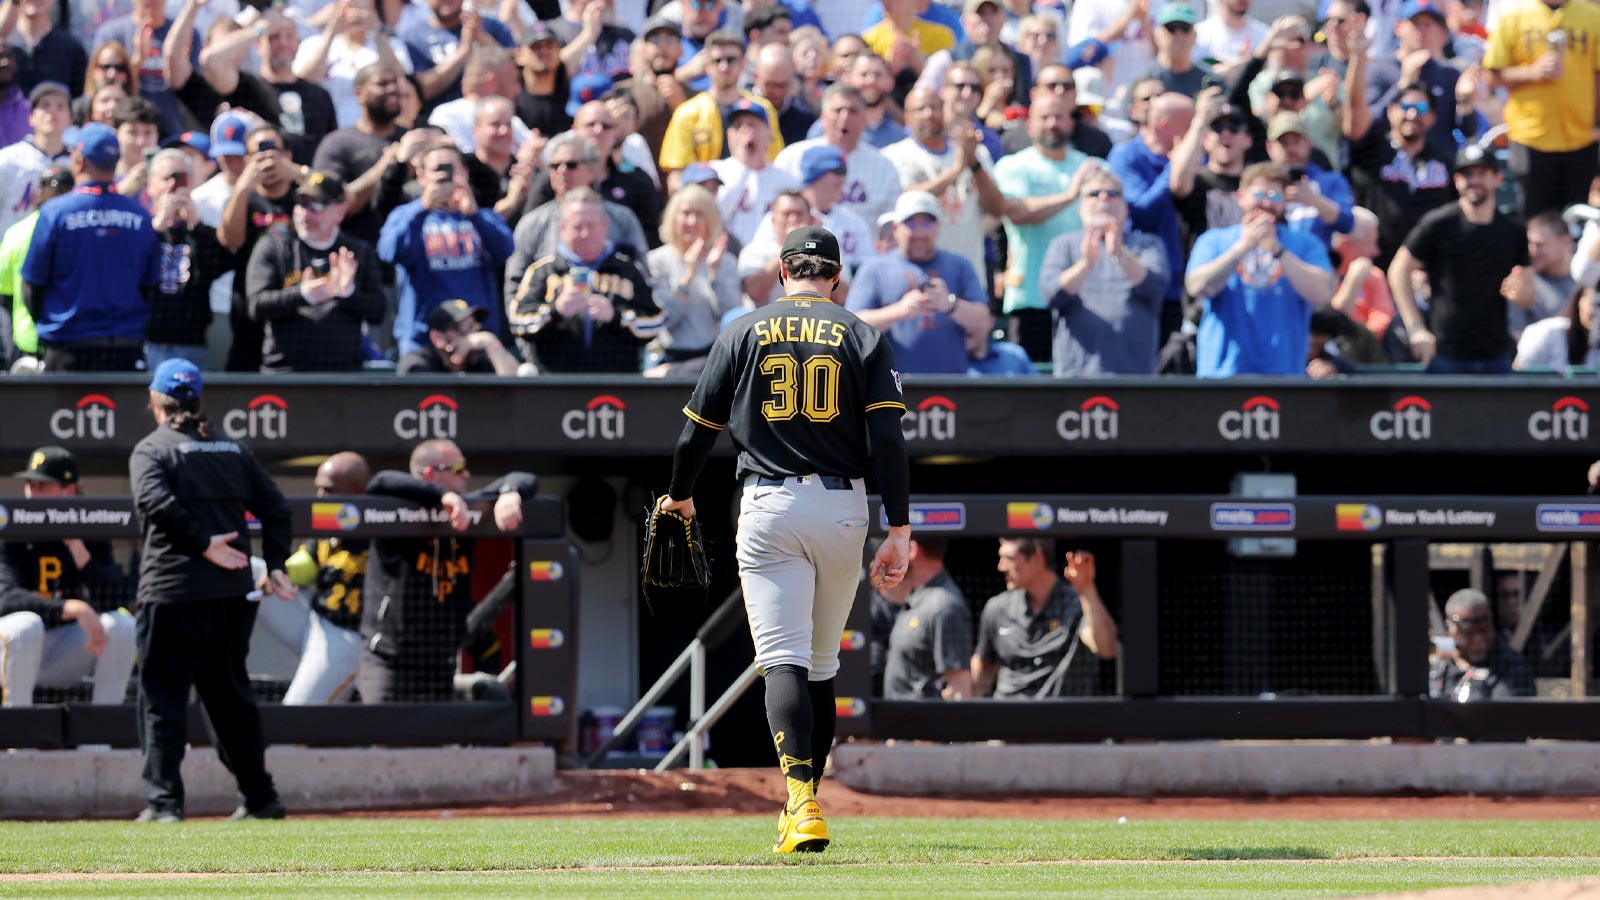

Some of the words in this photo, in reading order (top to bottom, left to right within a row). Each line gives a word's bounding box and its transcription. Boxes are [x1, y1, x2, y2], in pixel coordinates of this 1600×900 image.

[66, 209, 143, 230] SECURITY
[755, 317, 845, 347] SKENES
[759, 353, 842, 423] 30
[51, 404, 115, 439] citi
[223, 404, 287, 439] citi
[394, 404, 457, 439] citi
[562, 404, 624, 439] citi
[901, 405, 955, 440] citi
[1057, 405, 1118, 440] citi
[1218, 405, 1279, 440] citi
[1370, 406, 1430, 440] citi
[1528, 406, 1588, 440] citi
[31, 451, 45, 470] P
[13, 508, 46, 524] New
[46, 507, 79, 524] York
[80, 507, 131, 526] Lottery
[364, 508, 396, 524] New
[397, 507, 429, 523] York
[1057, 507, 1088, 523] New
[1088, 507, 1119, 523] York
[1119, 507, 1168, 526] Lottery
[1215, 509, 1289, 525] mets.com
[1385, 509, 1416, 525] New
[1416, 509, 1447, 525] York
[1447, 508, 1496, 527] Lottery
[39, 556, 62, 599] P
